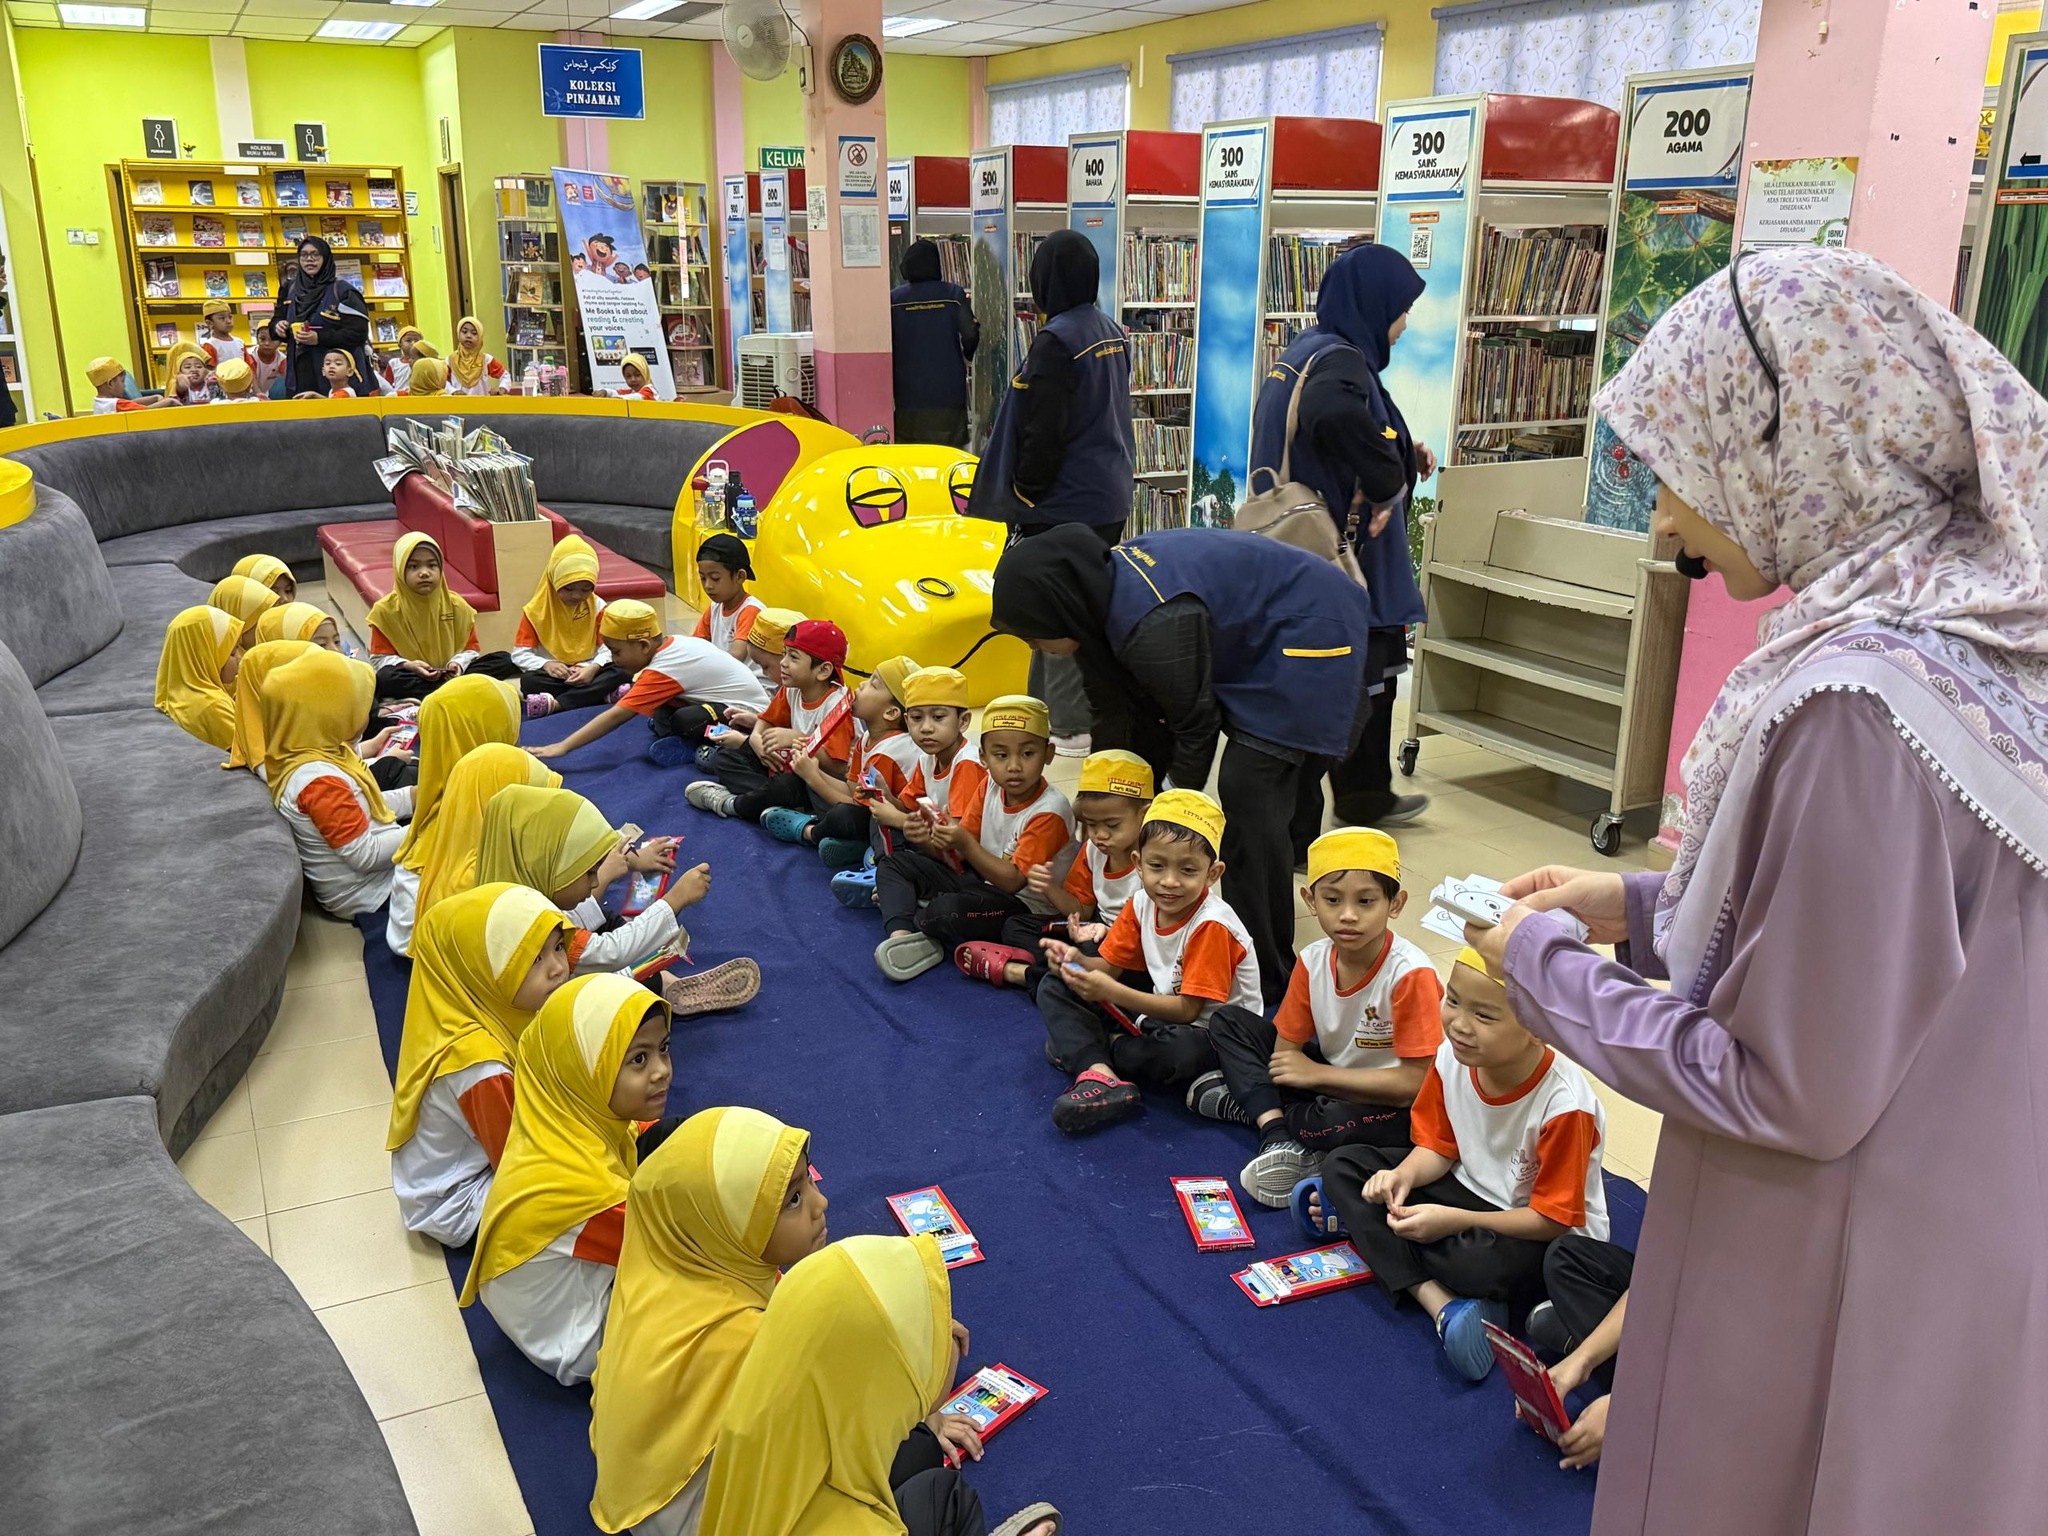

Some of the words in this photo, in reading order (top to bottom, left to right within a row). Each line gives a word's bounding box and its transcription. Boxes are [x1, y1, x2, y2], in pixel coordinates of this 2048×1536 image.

[570, 80, 616, 92] KOLEKSI
[566, 93, 620, 106] PINJAMAN
[1664, 109, 1710, 137] 200
[1412, 131, 1445, 155] 300
[1666, 141, 1703, 154] AGAMA
[766, 152, 805, 166] KELUA
[1221, 147, 1244, 167] 300
[1418, 158, 1437, 168] SAINS
[1086, 159, 1104, 176] 400
[1224, 170, 1238, 178] SAINS
[1395, 168, 1459, 180] KEMASYARAKATAN
[983, 171, 997, 186] 500
[1209, 179, 1254, 189] KEMASYARAKATAN
[890, 180, 901, 194] 600
